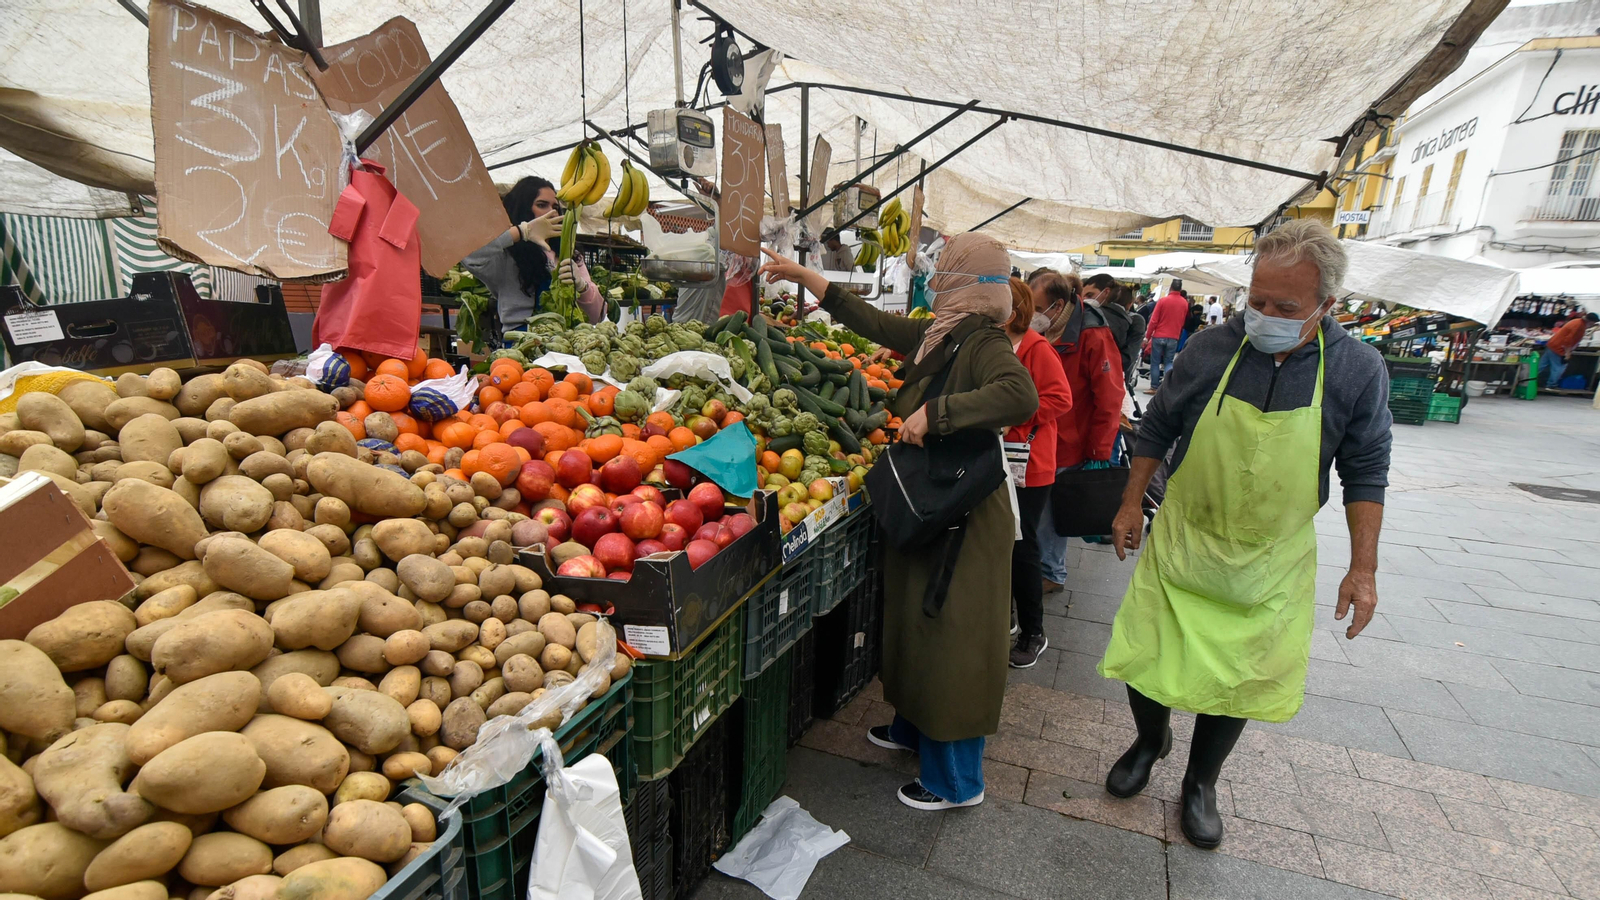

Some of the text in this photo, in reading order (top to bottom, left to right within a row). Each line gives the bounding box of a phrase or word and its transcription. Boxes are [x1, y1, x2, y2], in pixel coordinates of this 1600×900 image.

[169, 5, 318, 100] PAPAS
[1438, 116, 1478, 151] barrera
[1340, 213, 1368, 222] HOSTAL
[782, 529, 808, 559] Melinda
